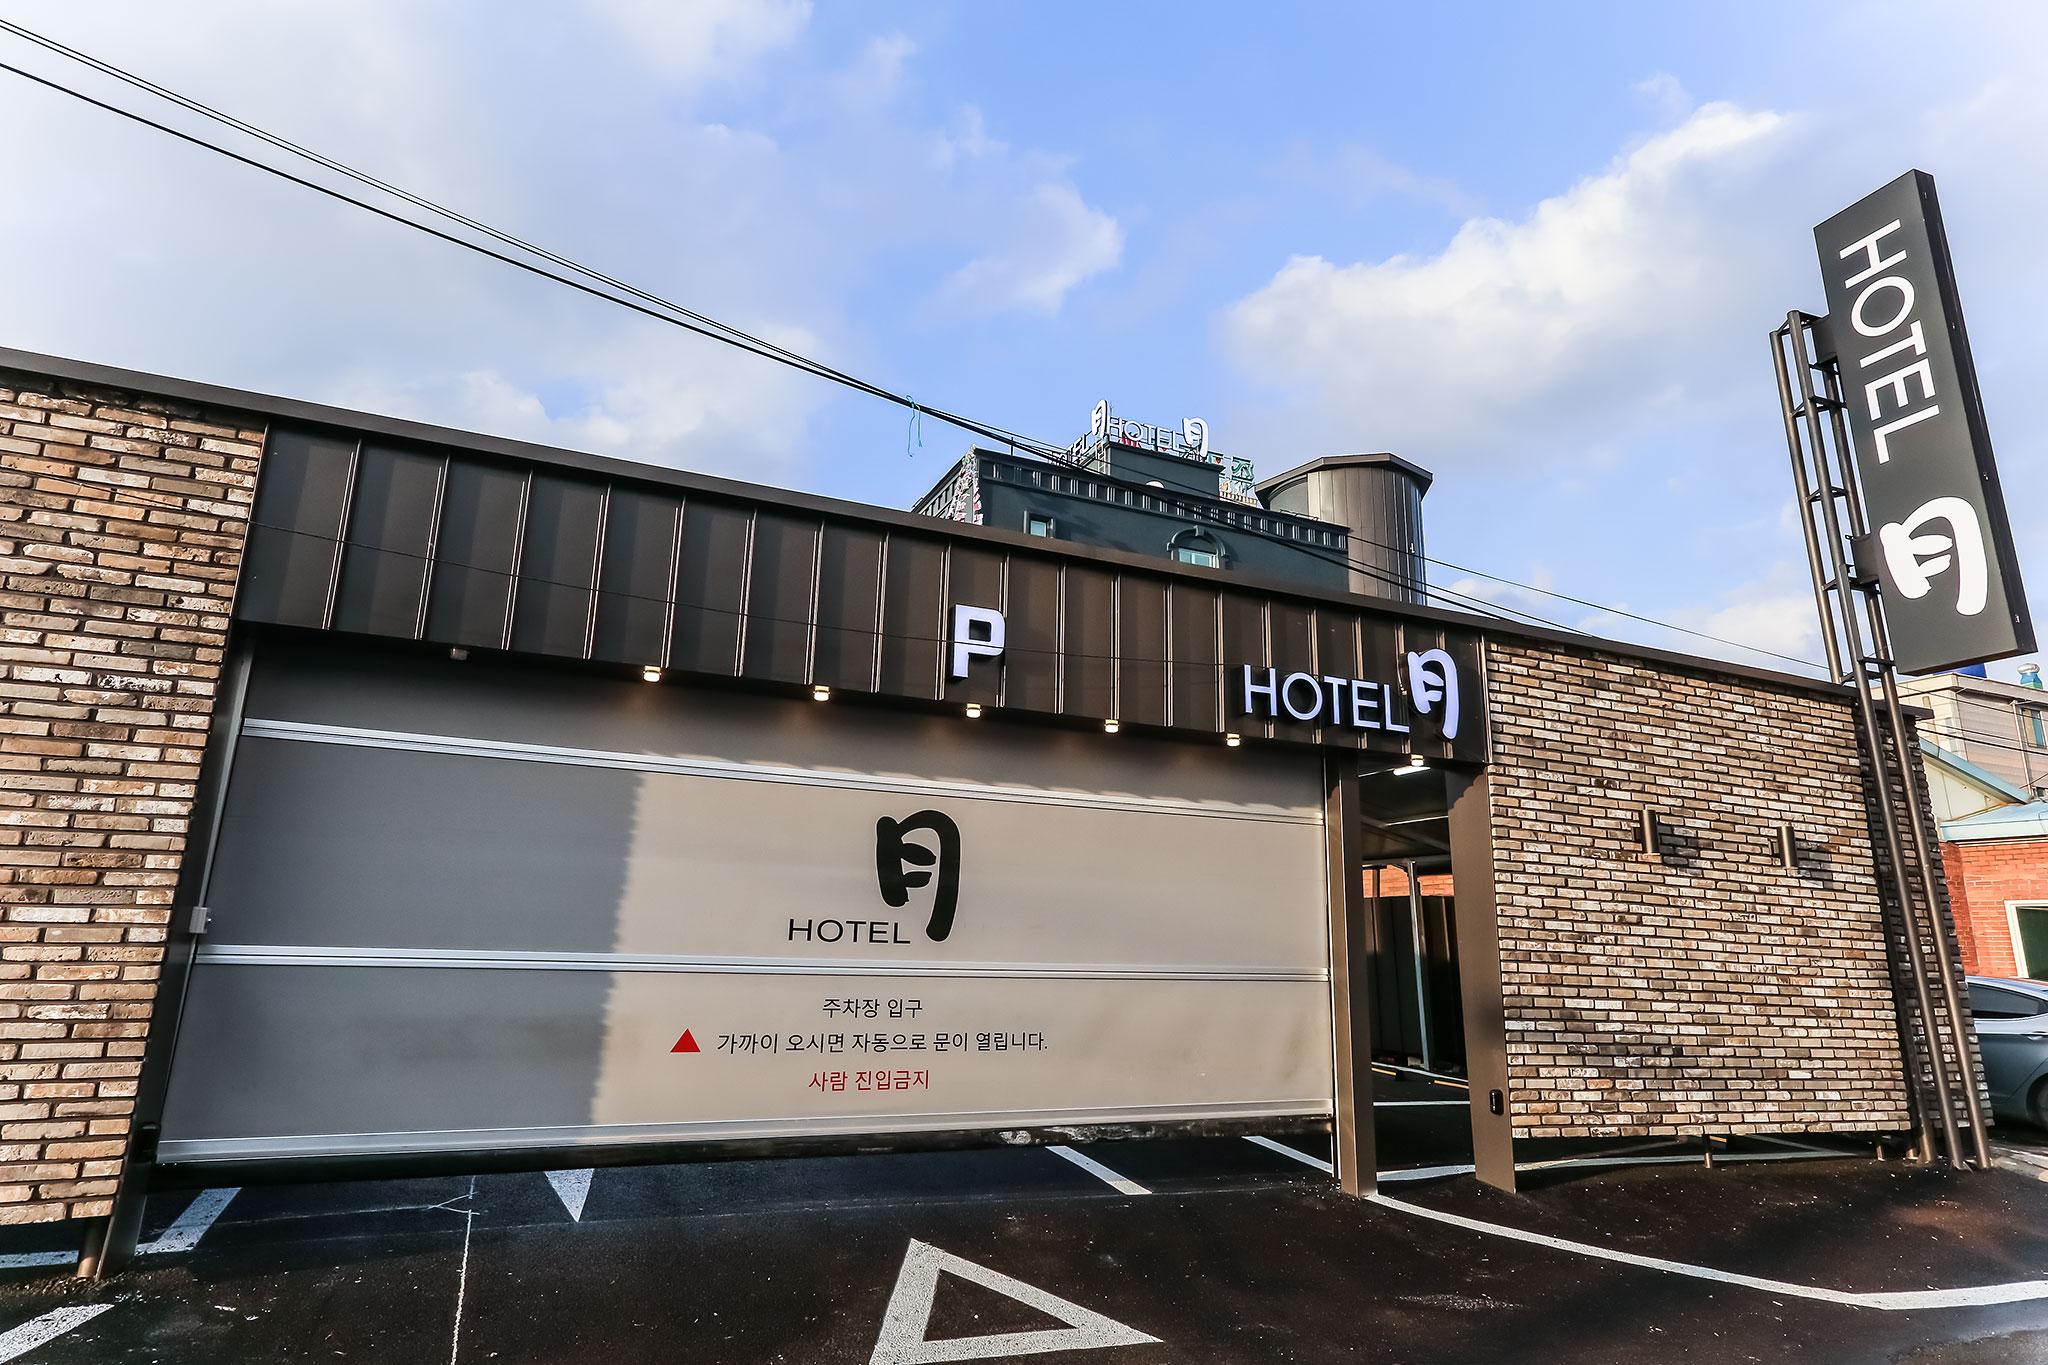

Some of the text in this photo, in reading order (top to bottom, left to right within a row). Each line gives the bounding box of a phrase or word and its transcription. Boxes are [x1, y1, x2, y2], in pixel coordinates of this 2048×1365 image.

[1839, 218, 1941, 465] HOTEL
[1107, 415, 1186, 453] HOTEL
[952, 605, 1005, 678] P
[1242, 664, 1411, 733] HOTEL
[787, 918, 911, 944] HOTEL
[822, 998, 923, 1018] 주차장 입구
[716, 1031, 1049, 1054] 가까이 오시면 자동으로 문이 열립니다.
[808, 1069, 930, 1092] 사람 진입금지
